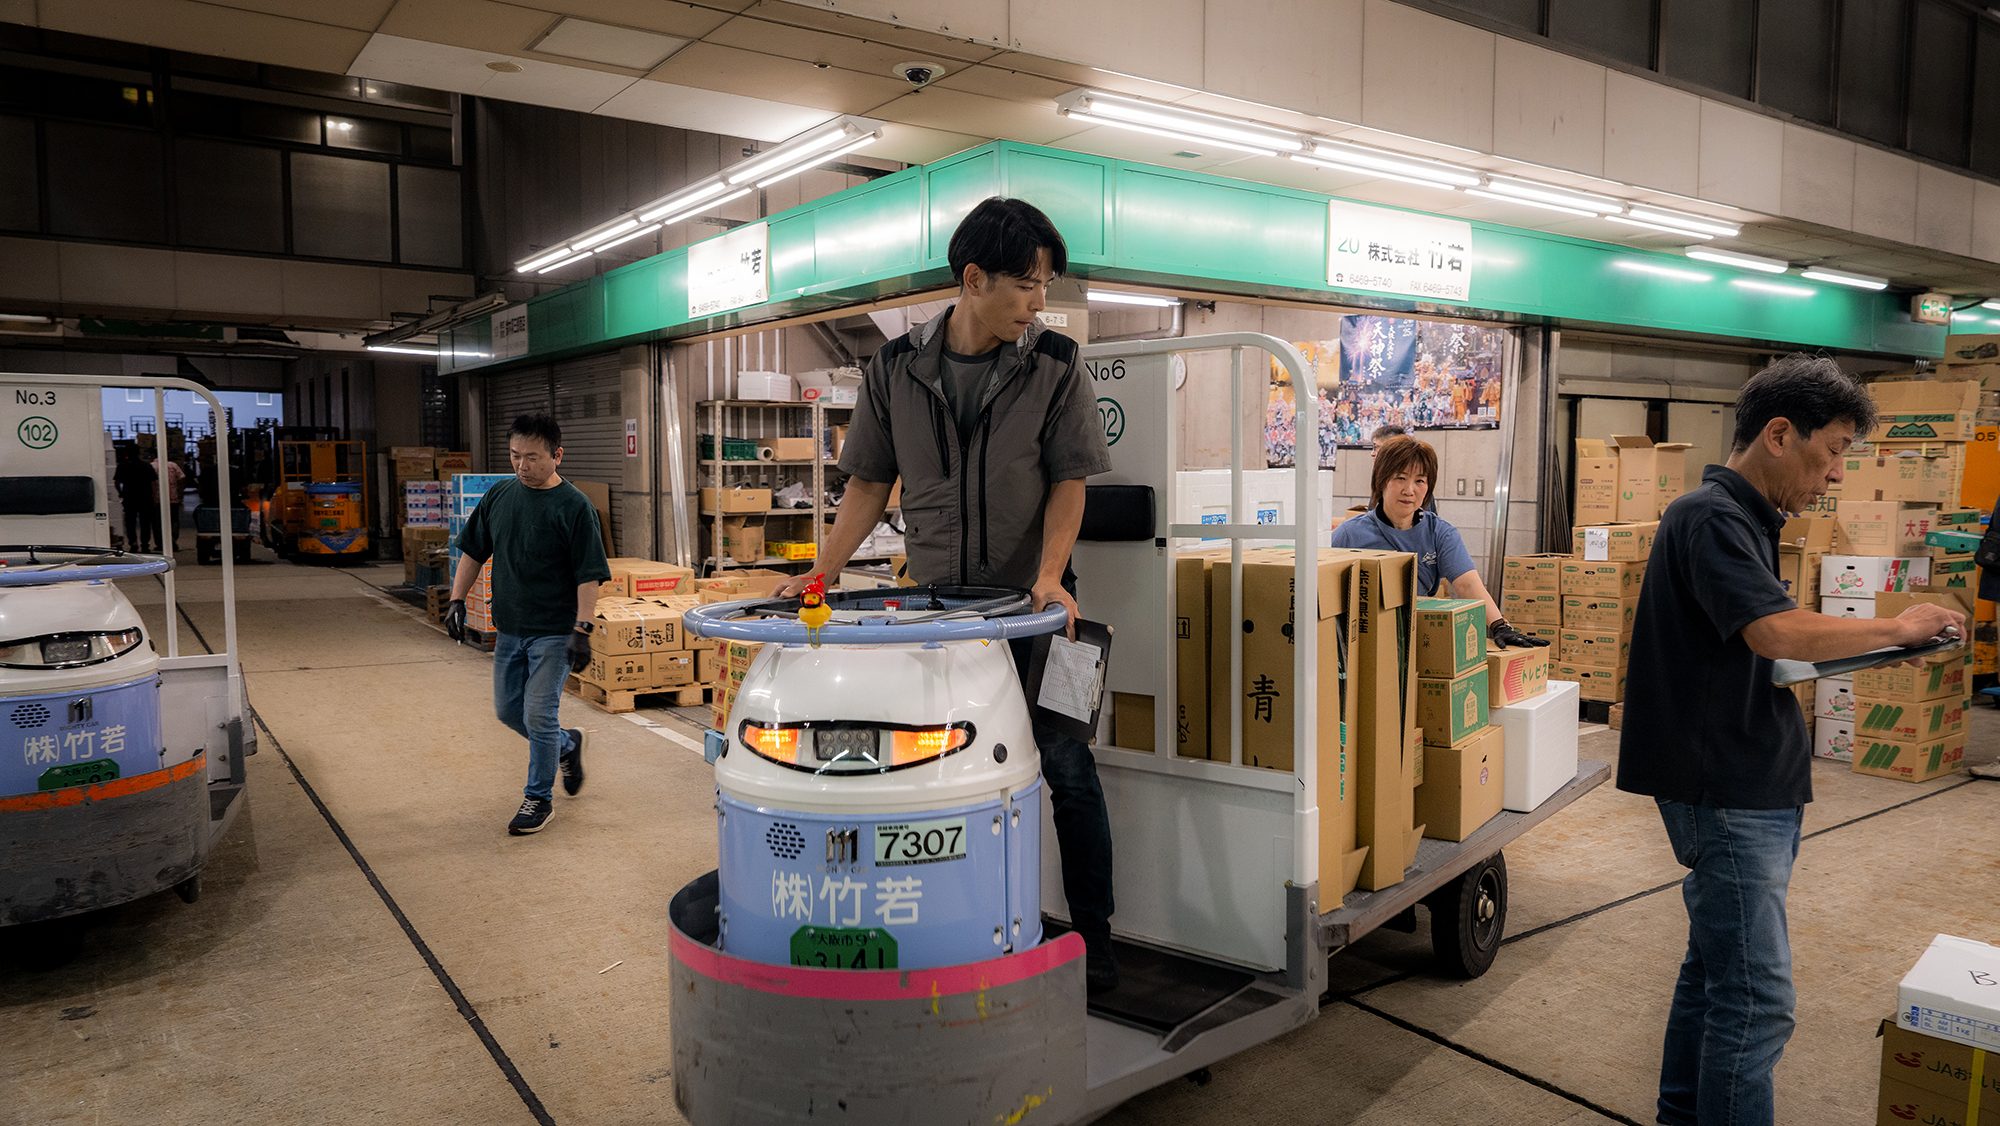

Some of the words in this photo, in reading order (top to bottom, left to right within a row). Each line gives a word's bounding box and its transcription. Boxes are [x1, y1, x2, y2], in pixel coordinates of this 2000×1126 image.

[1368, 242, 1420, 266] 株式会社
[1368, 321, 1387, 379] 天神祭
[16, 389, 56, 406] No.3
[24, 424, 52, 442] 102
[1246, 674, 1281, 724] 青
[879, 826, 963, 860] 7307
